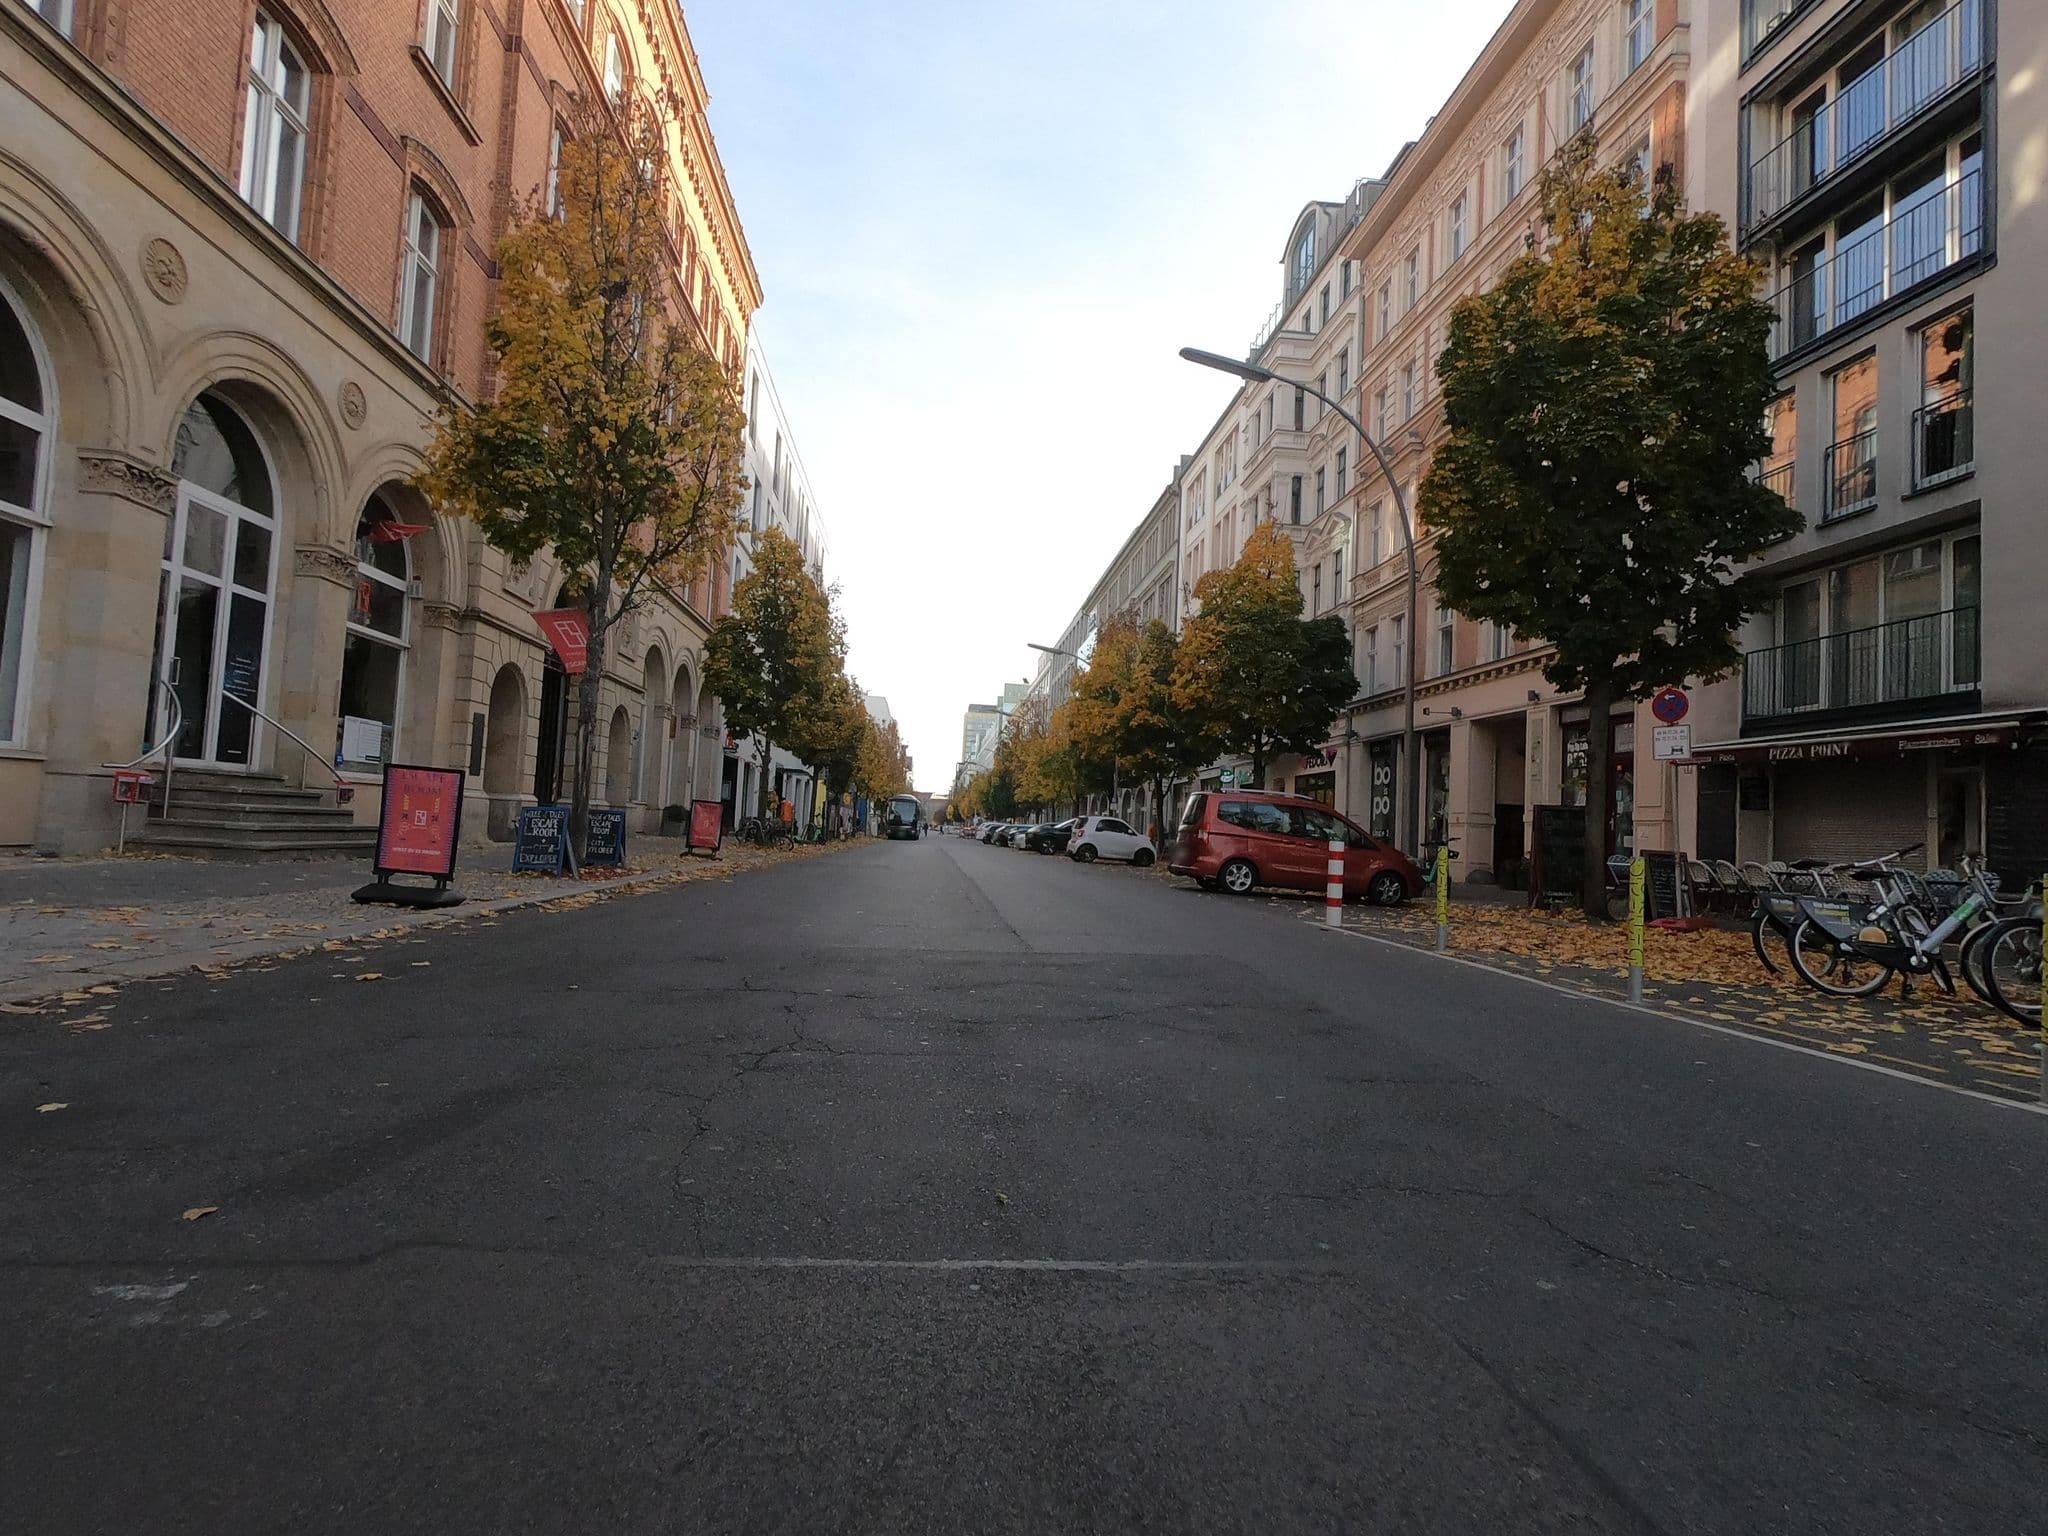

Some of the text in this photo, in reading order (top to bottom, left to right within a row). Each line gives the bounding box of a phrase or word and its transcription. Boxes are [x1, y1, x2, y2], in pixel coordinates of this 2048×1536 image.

[1768, 743, 1849, 760] PIZZA POINT
[531, 818, 559, 828] ESCAPE
[591, 819, 612, 828] ESCAPE
[533, 828, 558, 837] ROOM
